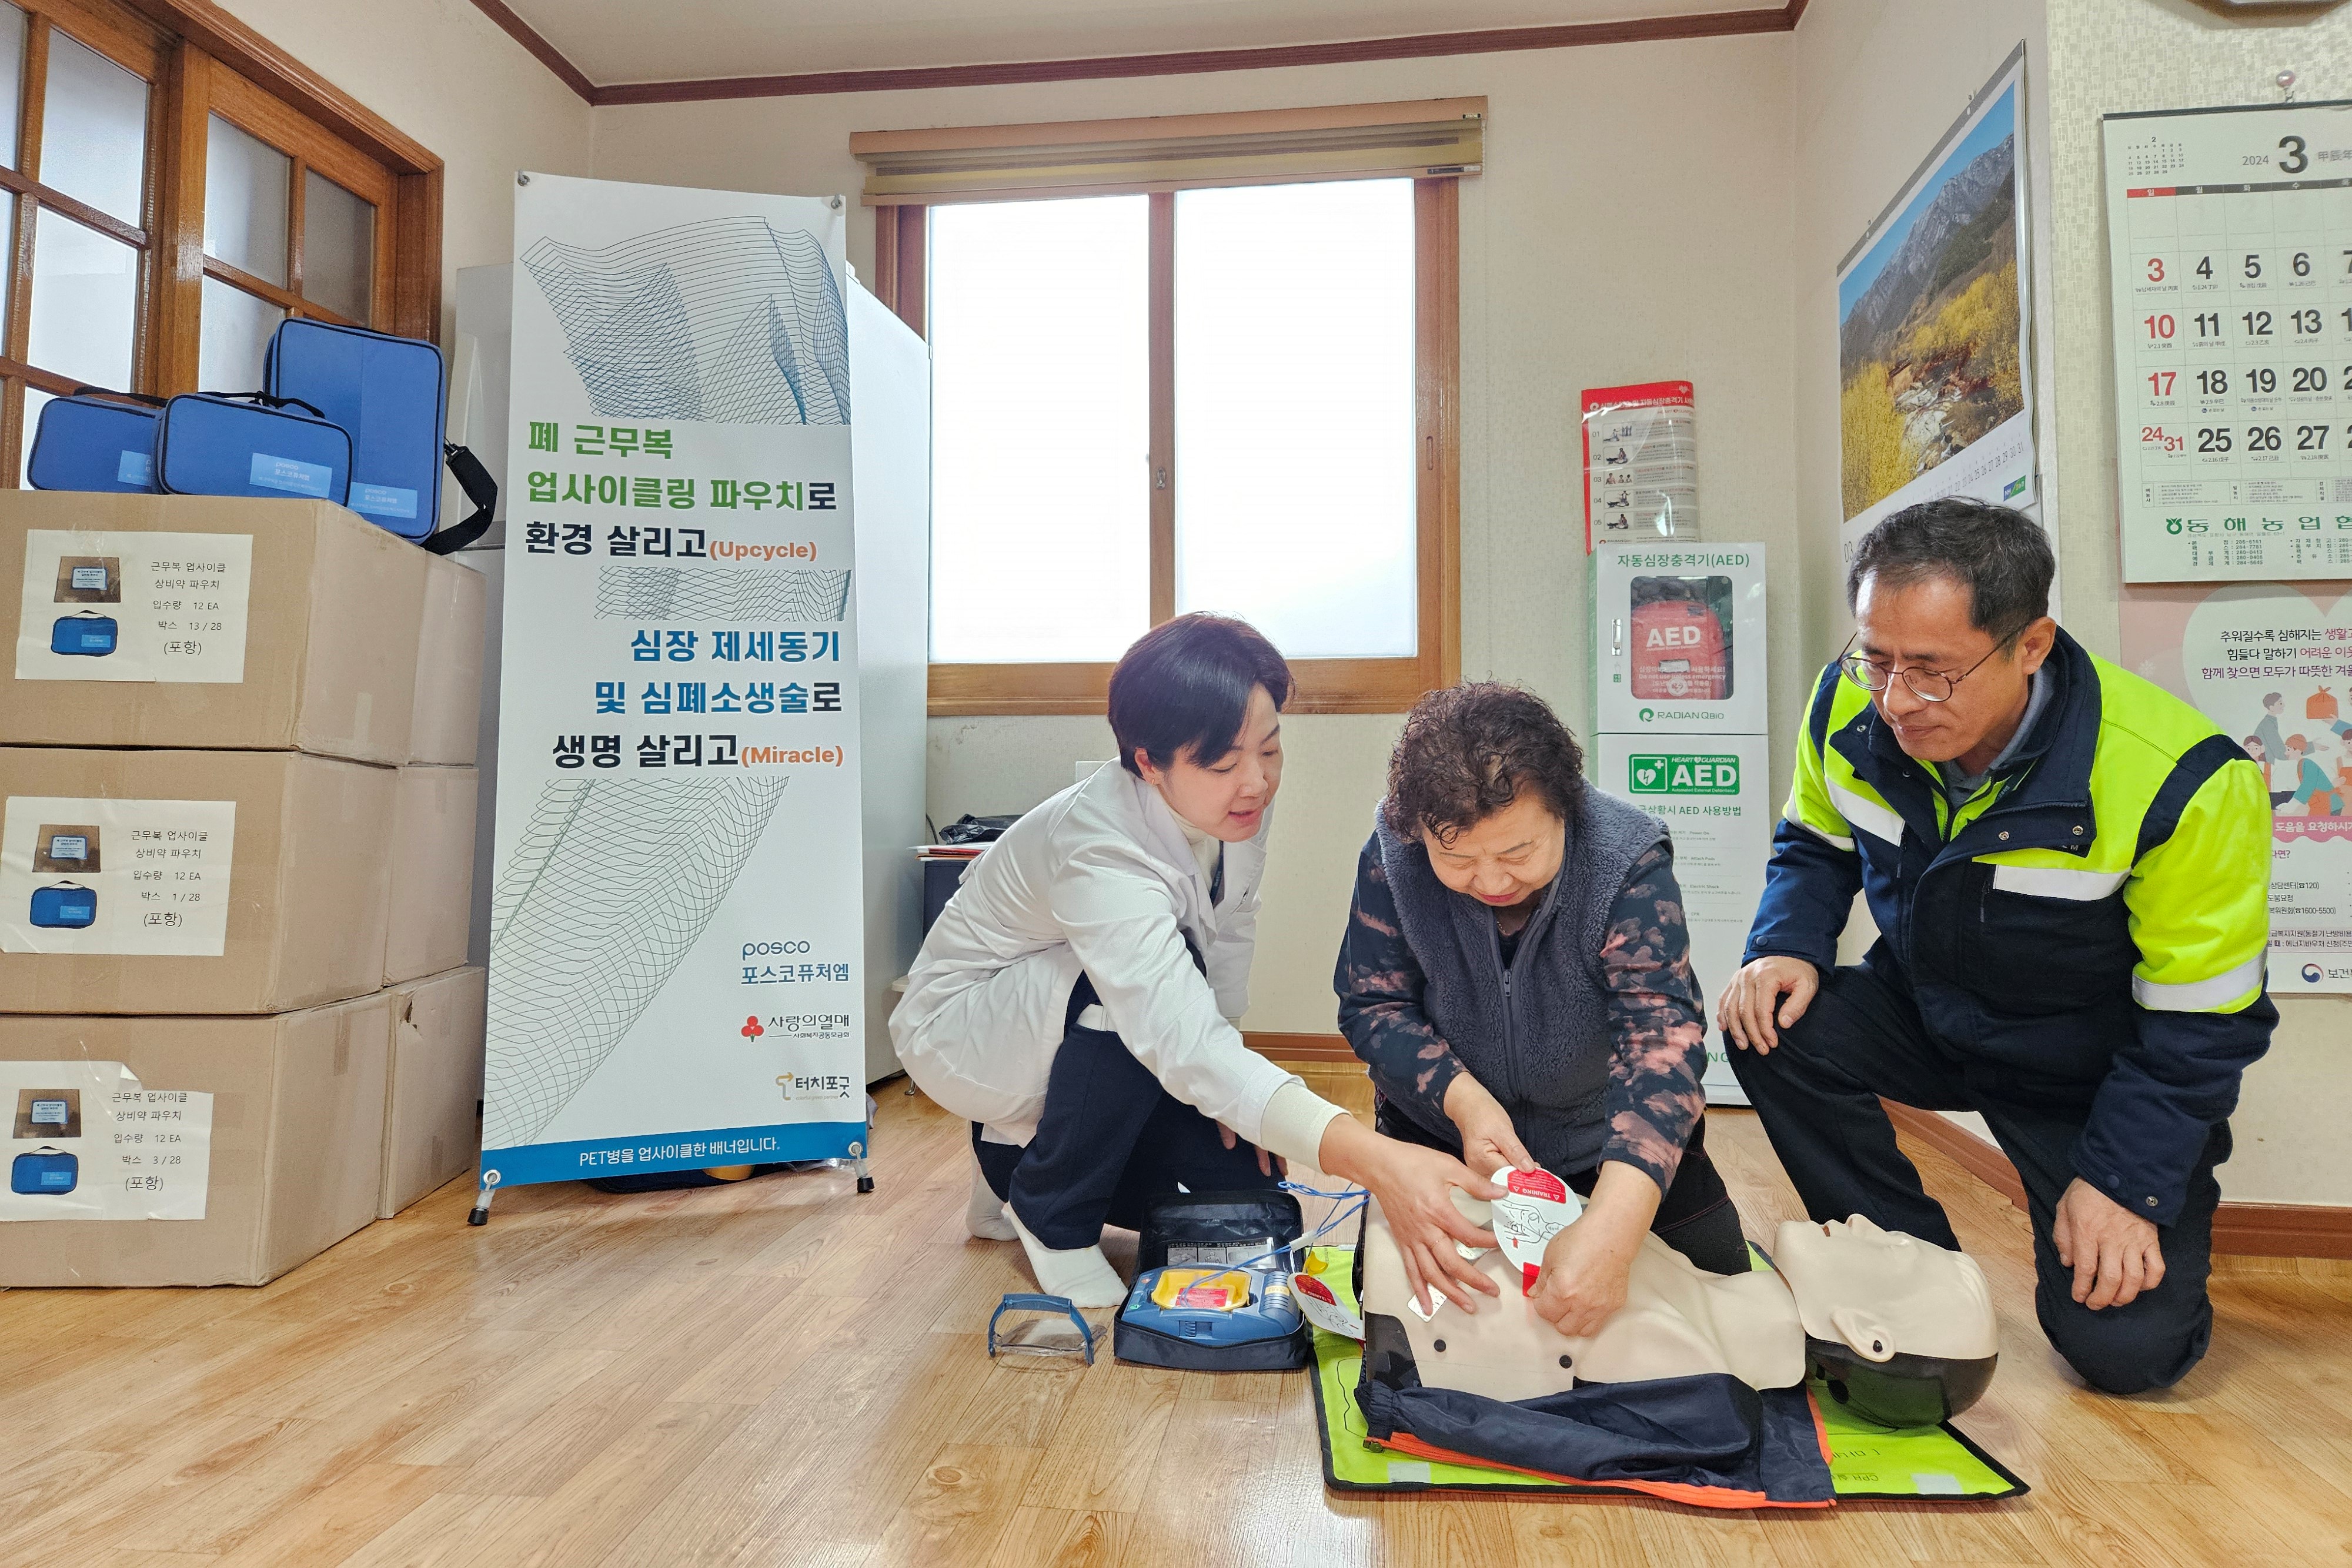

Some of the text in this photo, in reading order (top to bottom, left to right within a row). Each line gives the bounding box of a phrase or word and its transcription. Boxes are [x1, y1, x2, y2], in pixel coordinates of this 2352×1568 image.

[2242, 135, 2308, 173] 2024 3
[2147, 258, 2165, 282] 3
[2196, 256, 2213, 280] 4
[2244, 255, 2261, 278] 5
[2293, 252, 2310, 276] 6
[2144, 309, 2323, 339] 10 11 12 13
[2148, 372, 2176, 396] 17
[2197, 370, 2228, 394] 18
[2246, 369, 2276, 393] 19
[2293, 366, 2327, 392] 20
[529, 422, 673, 459] 폐 근무복
[2141, 427, 2164, 442] 24
[2164, 436, 2183, 451] 31
[2197, 428, 2232, 453] 25
[2247, 426, 2281, 451] 26
[2297, 425, 2330, 450] 27
[2003, 452, 2007, 463] 29
[2010, 446, 2016, 458] 30
[2018, 442, 2023, 453] 31
[528, 472, 836, 511] 업사이클링 파우치로
[525, 521, 592, 554] 환경
[151, 562, 226, 573] 근무복 업사이클
[1618, 554, 1749, 567] 자동심장충격기(AED)
[155, 579, 219, 589] 상비약 파우치
[153, 601, 181, 610] 입수량
[158, 621, 177, 630] 박스
[1646, 626, 1700, 647] AED
[2221, 630, 2275, 642] 추워질수록
[2278, 630, 2321, 641] 심해지는
[164, 641, 202, 655] (포항)
[631, 630, 839, 662] 심장 제세동기
[2227, 648, 2260, 660] 힘들다
[2264, 648, 2297, 660] 말하기
[2300, 647, 2332, 658] 어려운
[2202, 667, 2224, 680] 함께
[2227, 667, 2260, 678] 찾으면
[2263, 666, 2296, 677] 모두가
[2299, 666, 2332, 677] 따뜻한
[596, 681, 841, 714] 및 심폐소생술로
[553, 735, 621, 768] 생명
[1672, 765, 1736, 786] AED
[1703, 806, 1740, 816] 사용방법
[2276, 822, 2304, 832] 도움을
[132, 831, 208, 841] 근무복 업사이클
[136, 848, 201, 858] 상비약 파우치
[133, 871, 162, 880] 입수량
[142, 892, 160, 901] 박스
[144, 912, 182, 927] (포항)
[743, 941, 810, 961] posco
[741, 964, 848, 984] 포스코퓨처엠
[768, 1014, 849, 1032] 사랑의열매
[796, 1076, 850, 1098] 터치포굿
[112, 1093, 187, 1102] 근무복 업사이클
[116, 1111, 181, 1121] 상비약 파우치
[114, 1134, 143, 1143] 입수량
[580, 1138, 780, 1166] PET병을 업사이클한 배너입니다.
[122, 1155, 141, 1165] 박스
[126, 1176, 163, 1191] (포항)
[1522, 1189, 1551, 1198] TRAINING
